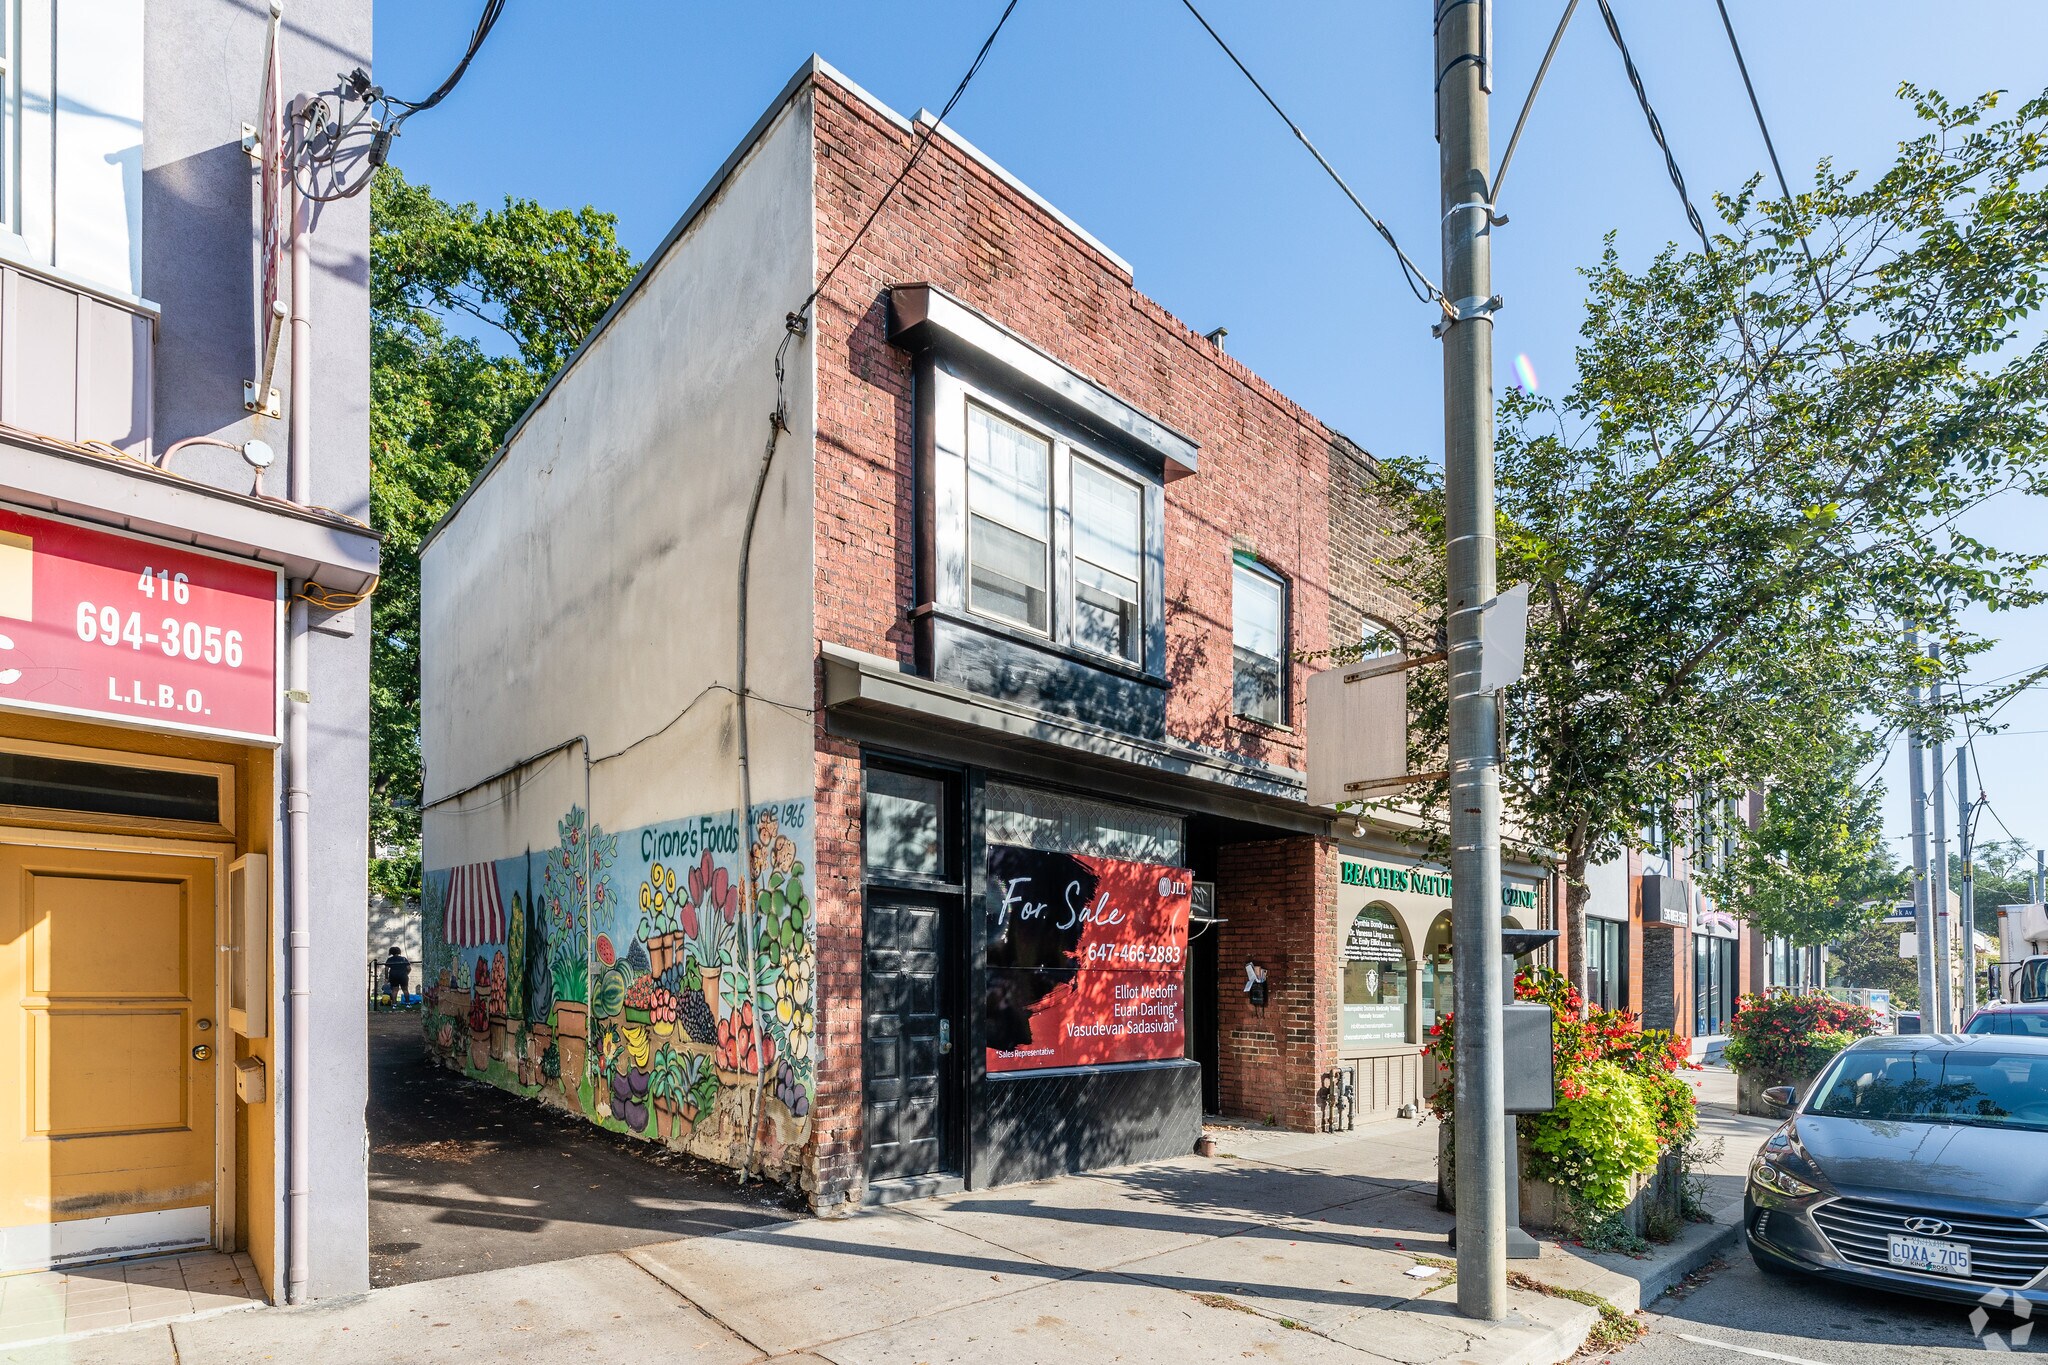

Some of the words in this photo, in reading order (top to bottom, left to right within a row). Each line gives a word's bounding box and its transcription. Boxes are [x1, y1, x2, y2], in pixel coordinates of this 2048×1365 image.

[137, 566, 190, 605] 416
[76, 601, 243, 668] 694-3056
[108, 677, 211, 715] L.L.B.O.
[641, 819, 698, 863] Cirone's
[700, 808, 739, 854] Foods
[781, 803, 805, 828] 1966
[1340, 861, 1410, 893] BEACHES
[1410, 872, 1453, 898] NATUR
[1502, 887, 1538, 910] CLINIC
[998, 877, 1047, 926] For
[1056, 880, 1126, 931] Sale
[1088, 943, 1181, 964] 647-466-2883
[1115, 985, 1139, 999] Elliot
[1114, 1003, 1138, 1017] Euan
[1067, 1022, 1125, 1038] Vasudevan
[1014, 1048, 1055, 1059] Representative
[1892, 1243, 1929, 1262] CDXA
[1939, 1249, 1968, 1268] 705
